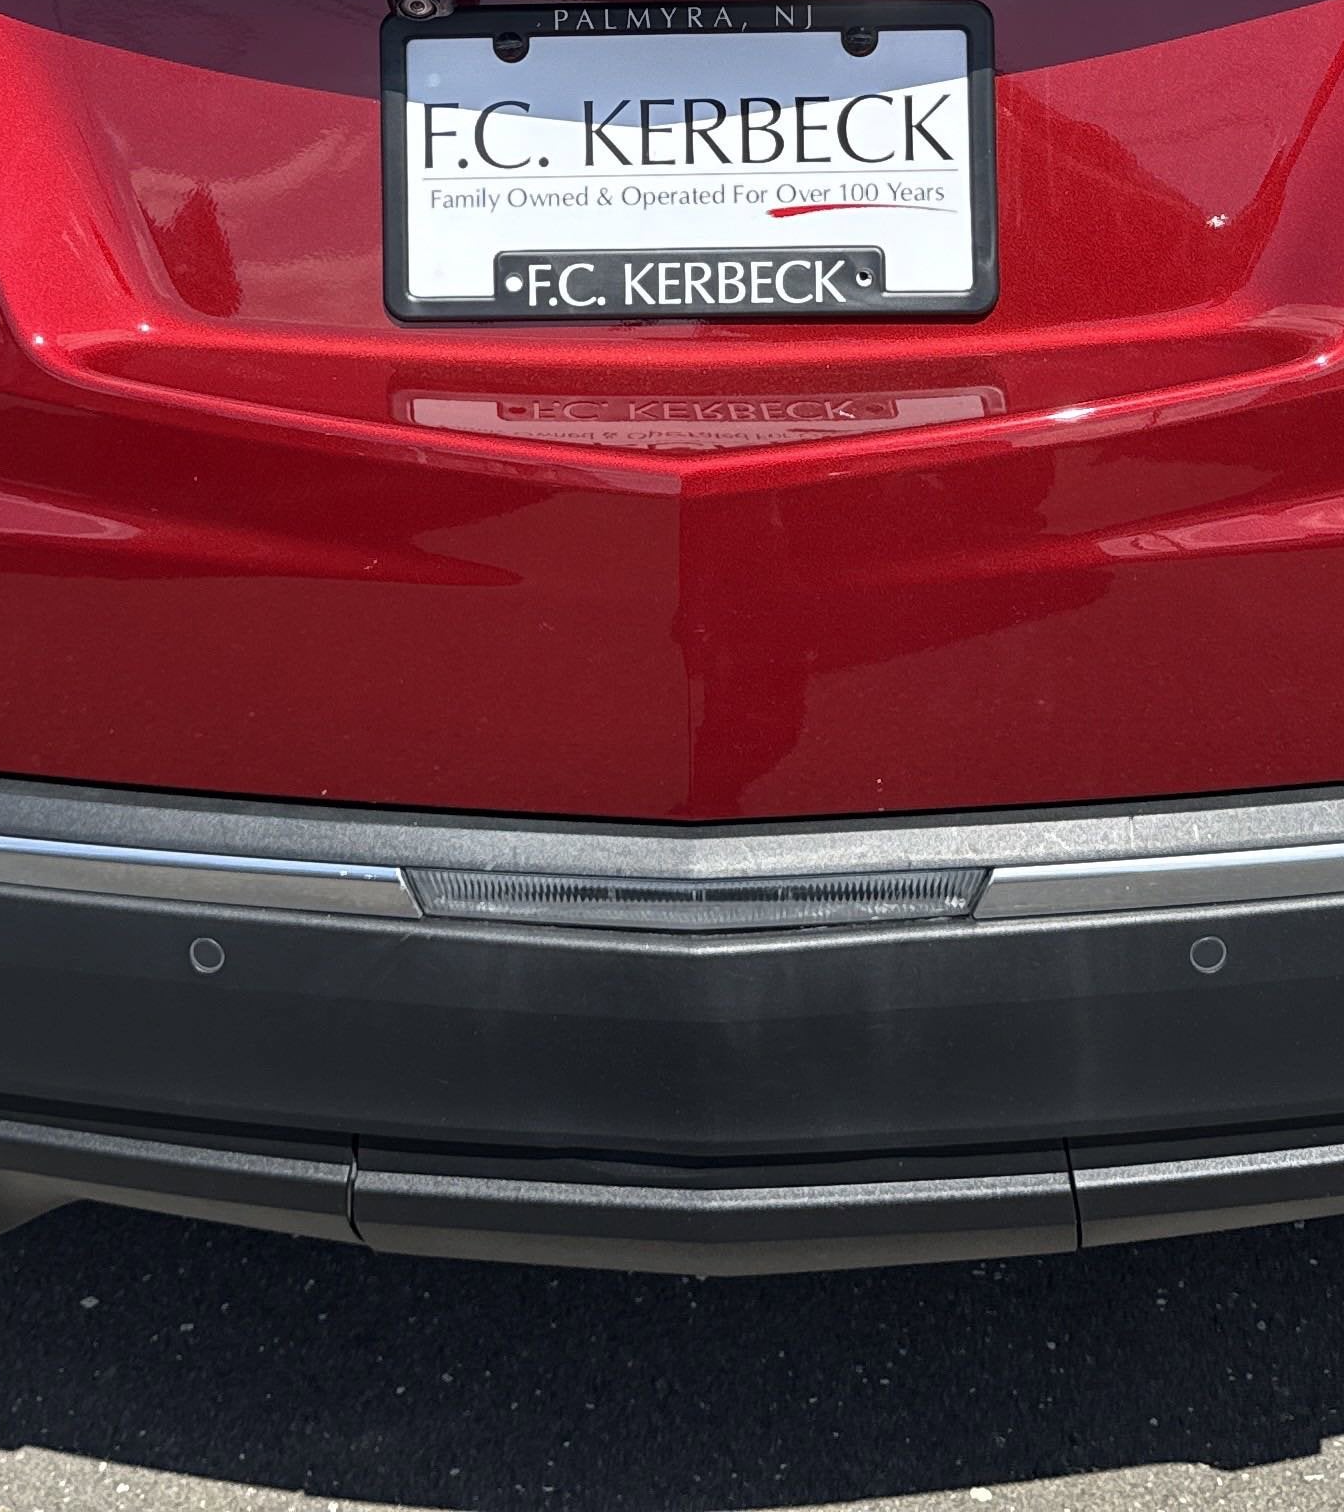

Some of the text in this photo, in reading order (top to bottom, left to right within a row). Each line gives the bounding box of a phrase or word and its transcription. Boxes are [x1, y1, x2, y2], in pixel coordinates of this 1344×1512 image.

[554, 5, 813, 32] PALMYRA, NJ
[424, 94, 954, 169] F.C. KERBECK
[430, 182, 945, 213] Family Owned & Operated For Over 100 Years
[528, 259, 847, 307] F.C. KERBECK
